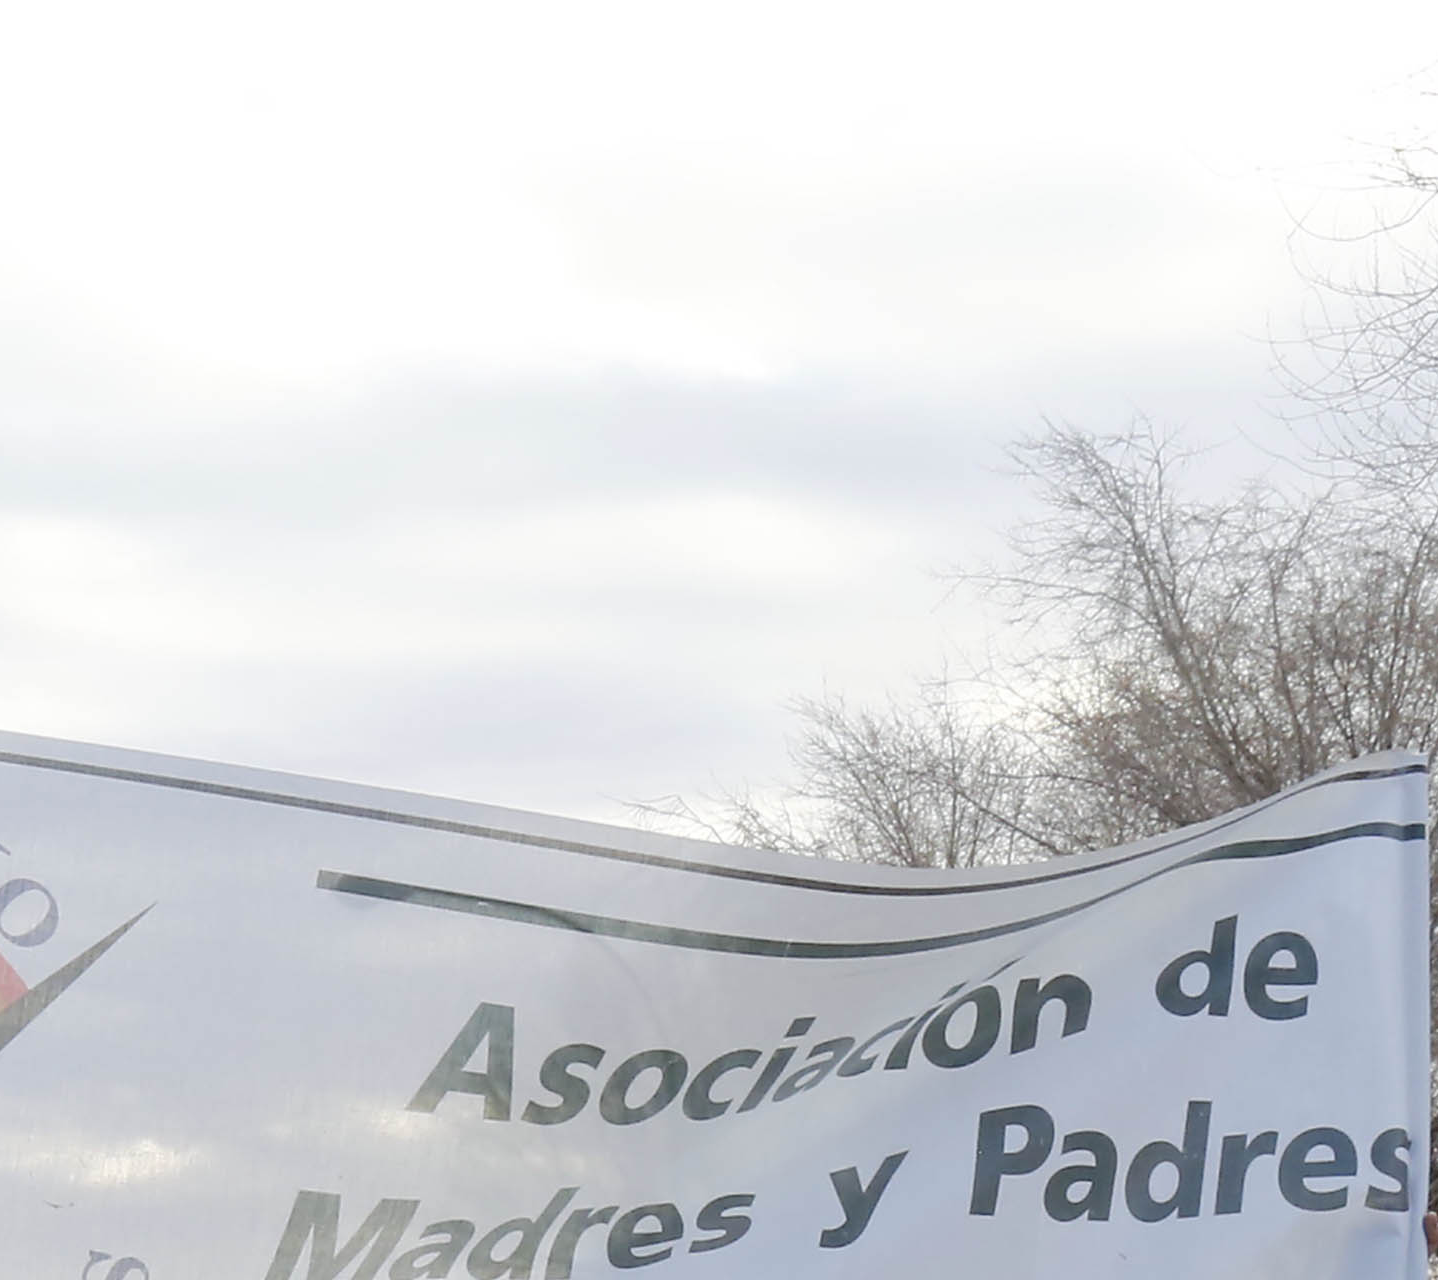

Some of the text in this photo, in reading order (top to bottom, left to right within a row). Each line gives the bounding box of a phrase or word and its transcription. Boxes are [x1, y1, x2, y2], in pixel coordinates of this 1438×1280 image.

[406, 914, 1319, 1125] Asociación de
[818, 1148, 908, 1249] y
[968, 1100, 1412, 1223] Padres
